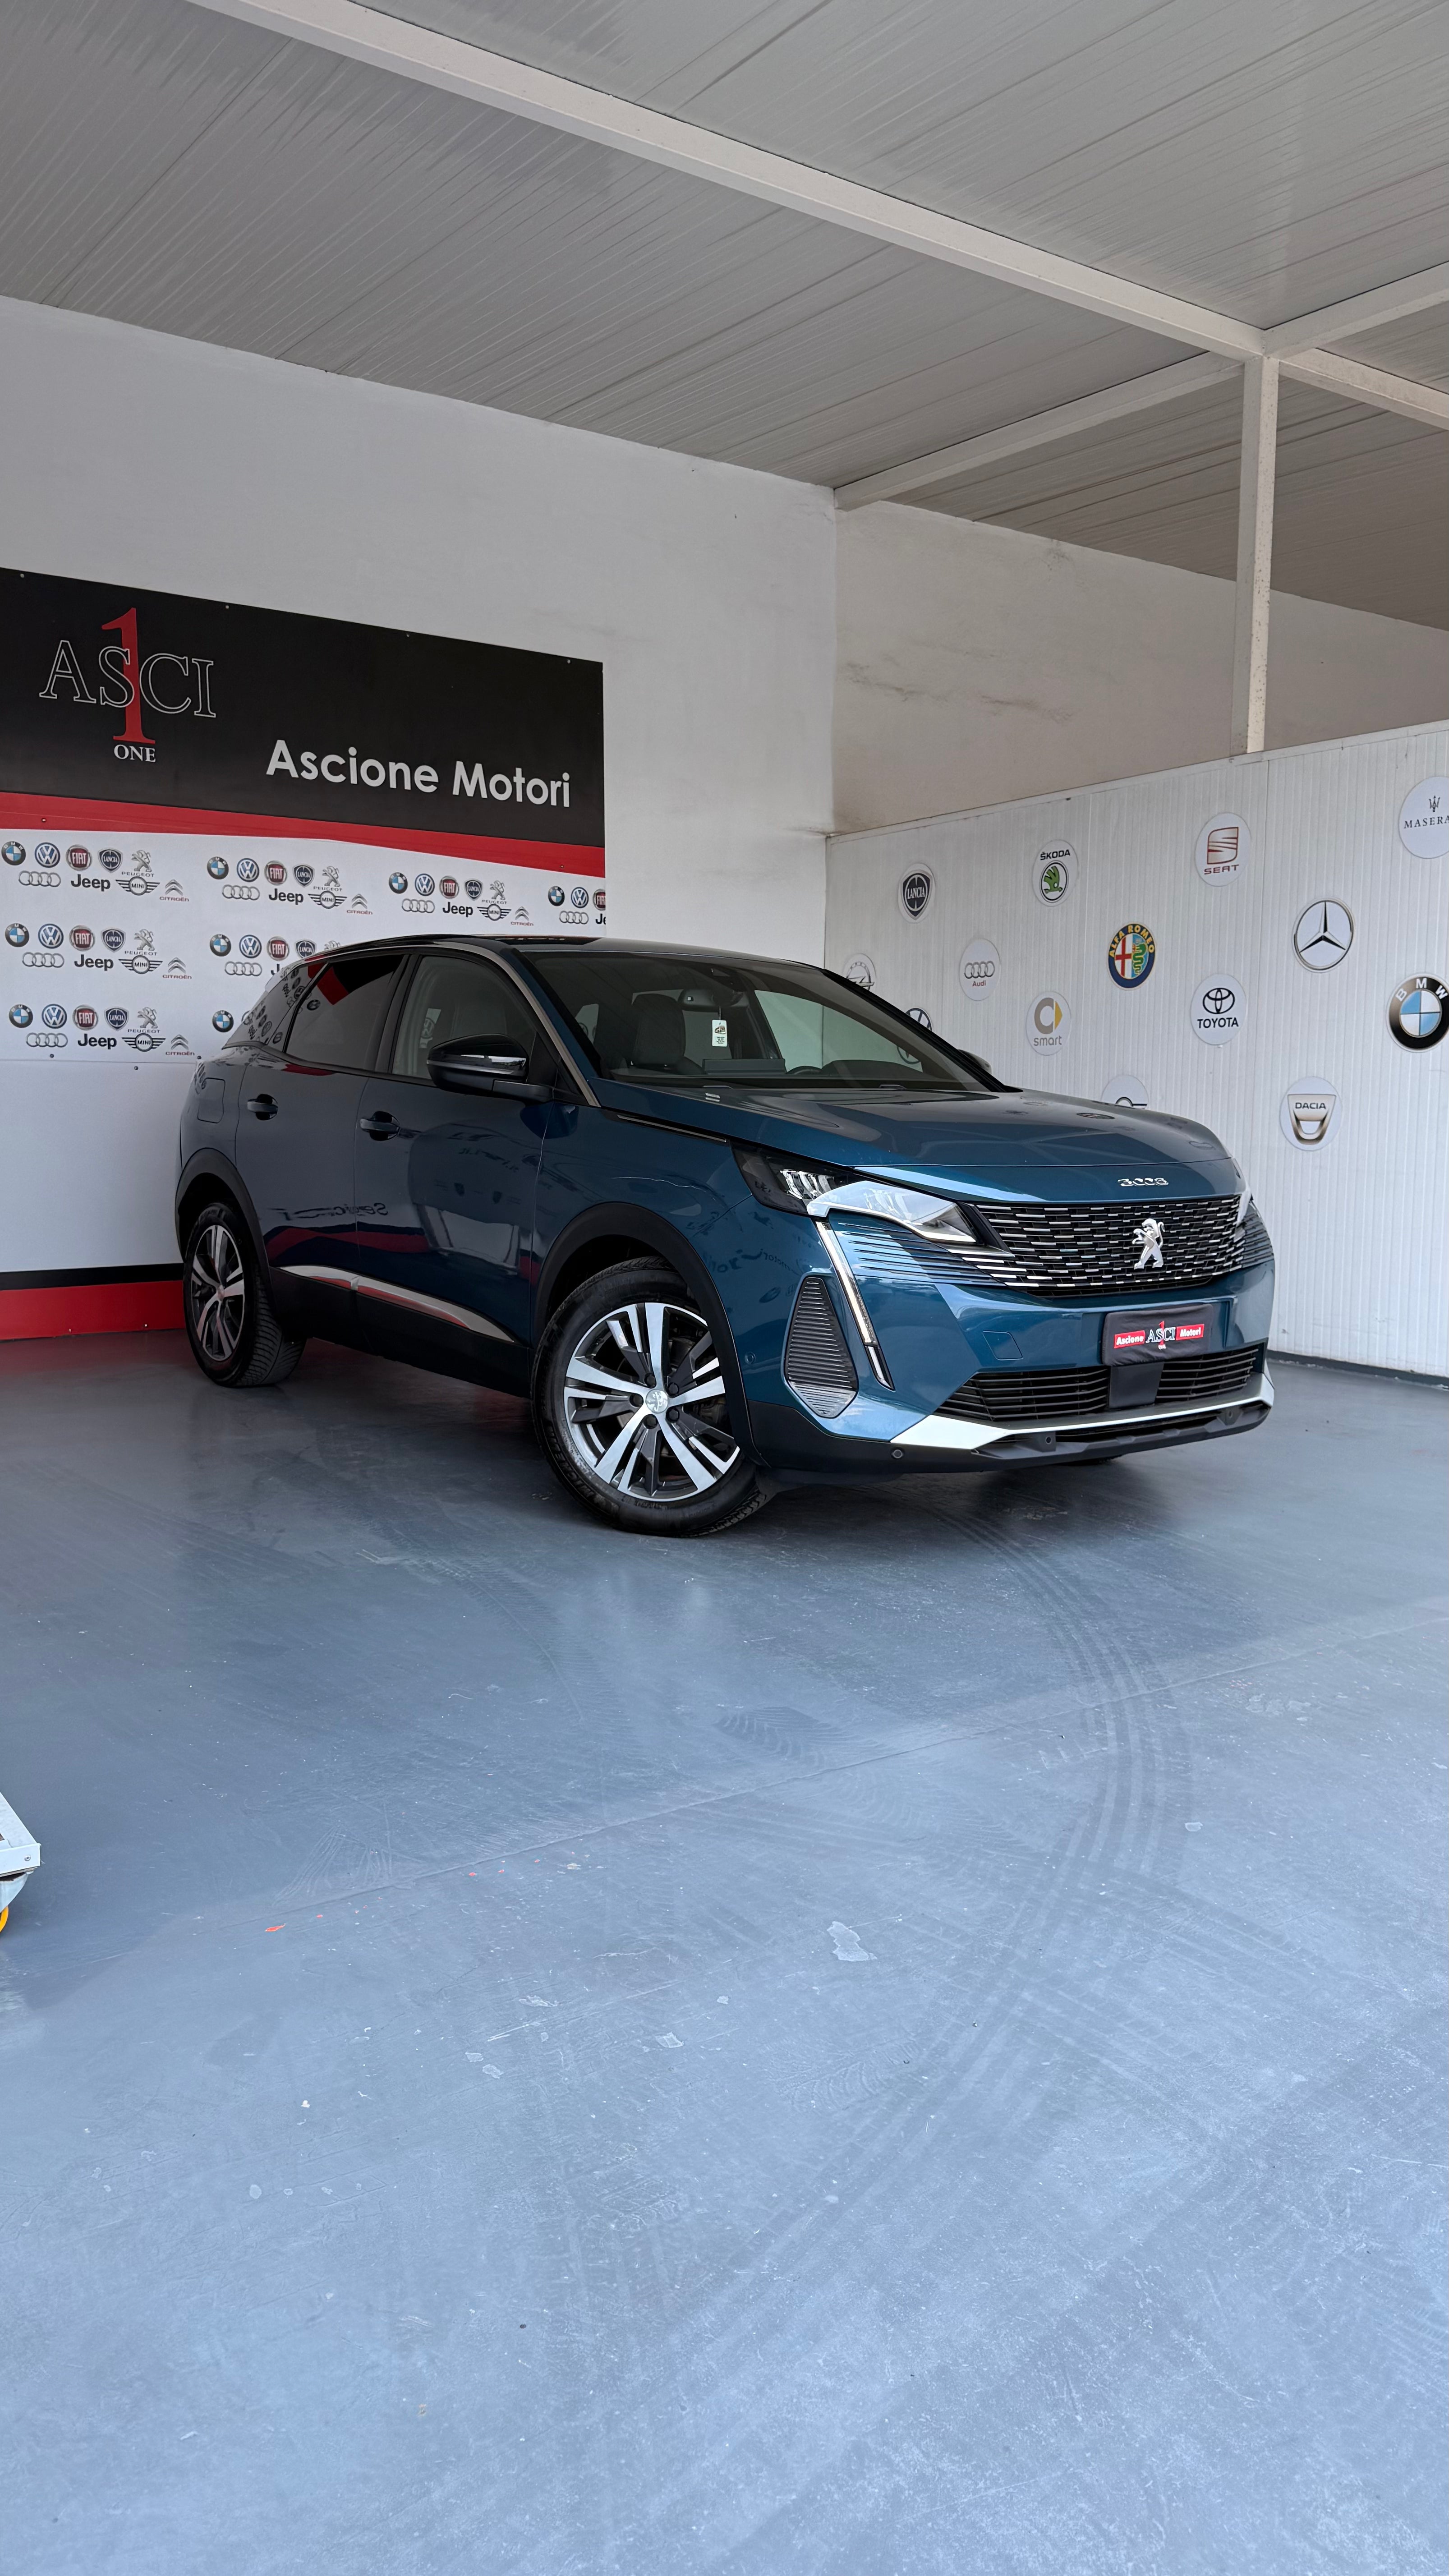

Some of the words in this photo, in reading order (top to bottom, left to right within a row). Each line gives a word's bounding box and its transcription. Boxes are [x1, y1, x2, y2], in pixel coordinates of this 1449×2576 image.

[39, 639, 216, 718] ASCI
[114, 744, 156, 763] ONE
[267, 740, 439, 793] Ascione
[452, 761, 570, 807] Motori
[72, 852, 87, 865] FIAT
[1040, 848, 1071, 860] ŠKODA
[270, 867, 284, 879] FIAT
[1204, 864, 1240, 875] SEAT
[71, 874, 111, 892] Jeep
[444, 882, 455, 894] FIAT
[268, 888, 304, 905] Jeep
[906, 886, 926, 900] LANCIA
[442, 902, 474, 918] Jeep
[75, 933, 90, 945] FIAT
[1109, 930, 1126, 958] ALFA
[1128, 925, 1155, 953] ROMEO
[271, 943, 285, 955] FIAT
[74, 954, 114, 971] Jeep
[972, 979, 987, 987] Audi
[1395, 977, 1449, 1001] BMW
[78, 1012, 93, 1024] FIAT
[1197, 1017, 1239, 1029] TOYOTA
[78, 1033, 117, 1050] Jeep
[1033, 1035, 1063, 1047] smart
[1295, 1101, 1327, 1110] DACIA
[1116, 1335, 1144, 1346] Ascione
[1145, 1327, 1176, 1343] ASCI
[1180, 1327, 1201, 1337] Motori
